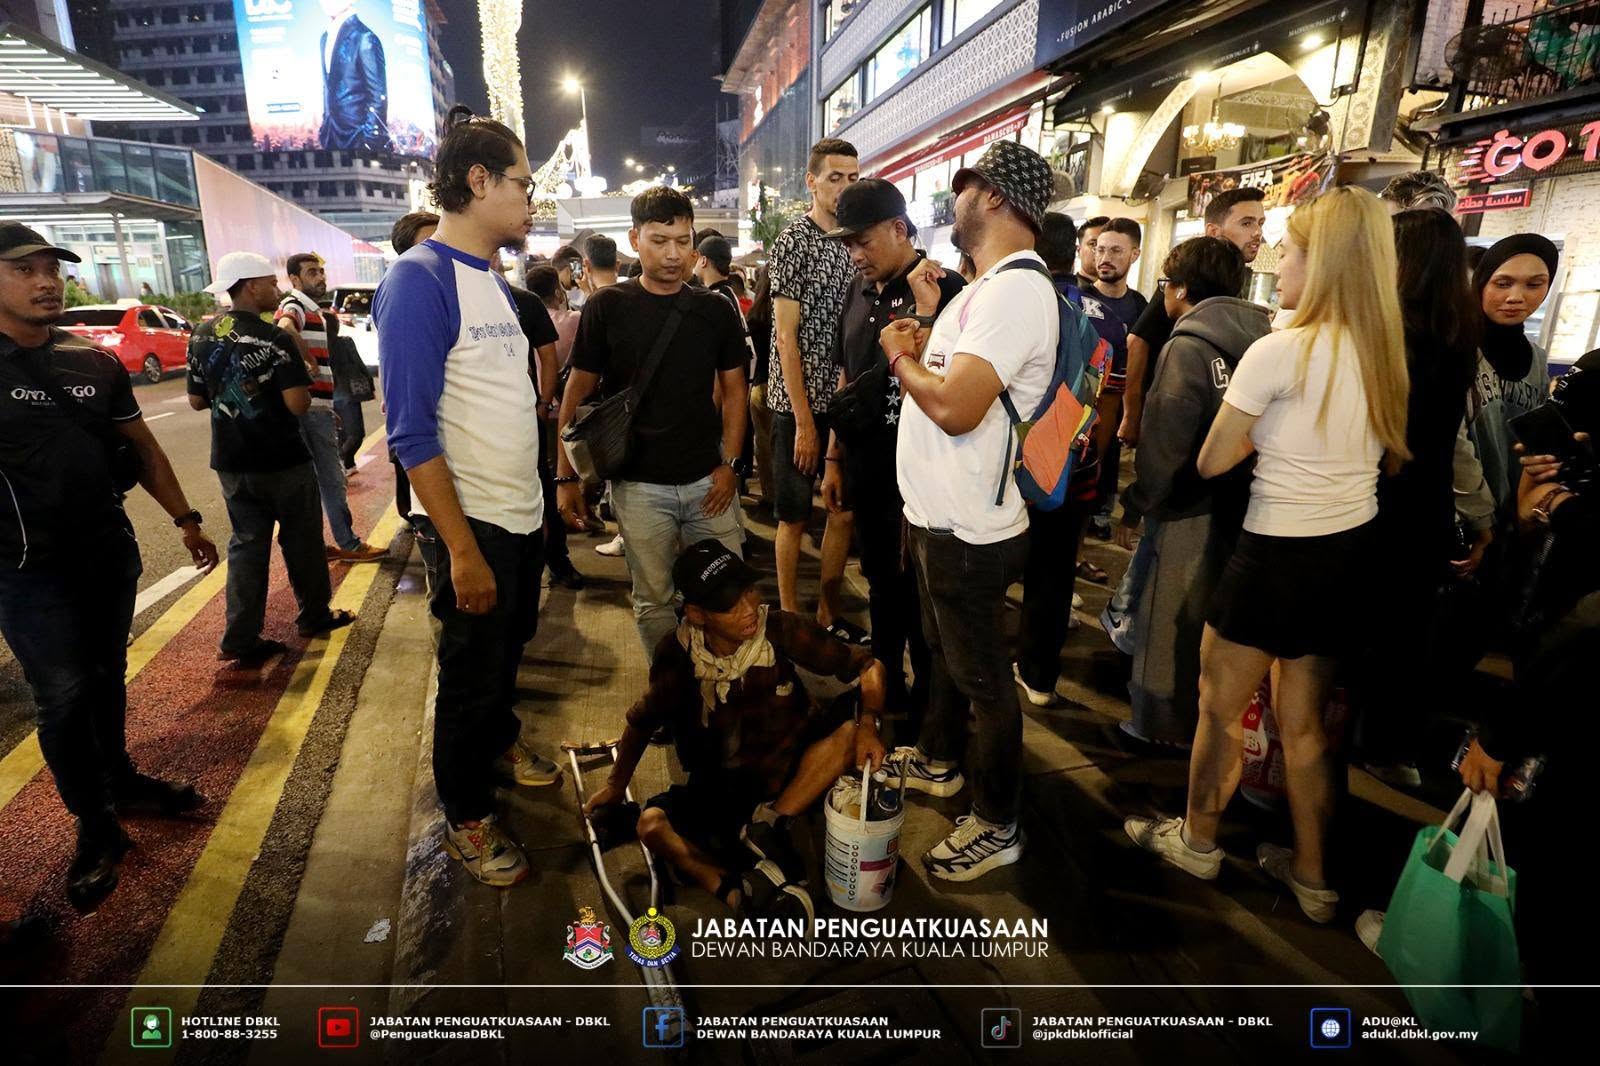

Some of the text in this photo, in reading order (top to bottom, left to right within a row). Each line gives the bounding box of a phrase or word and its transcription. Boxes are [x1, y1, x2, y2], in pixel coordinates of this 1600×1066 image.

[1484, 129, 1567, 177] GO
[1239, 168, 1274, 189] FIFA
[701, 554, 731, 581] BROOKLYN
